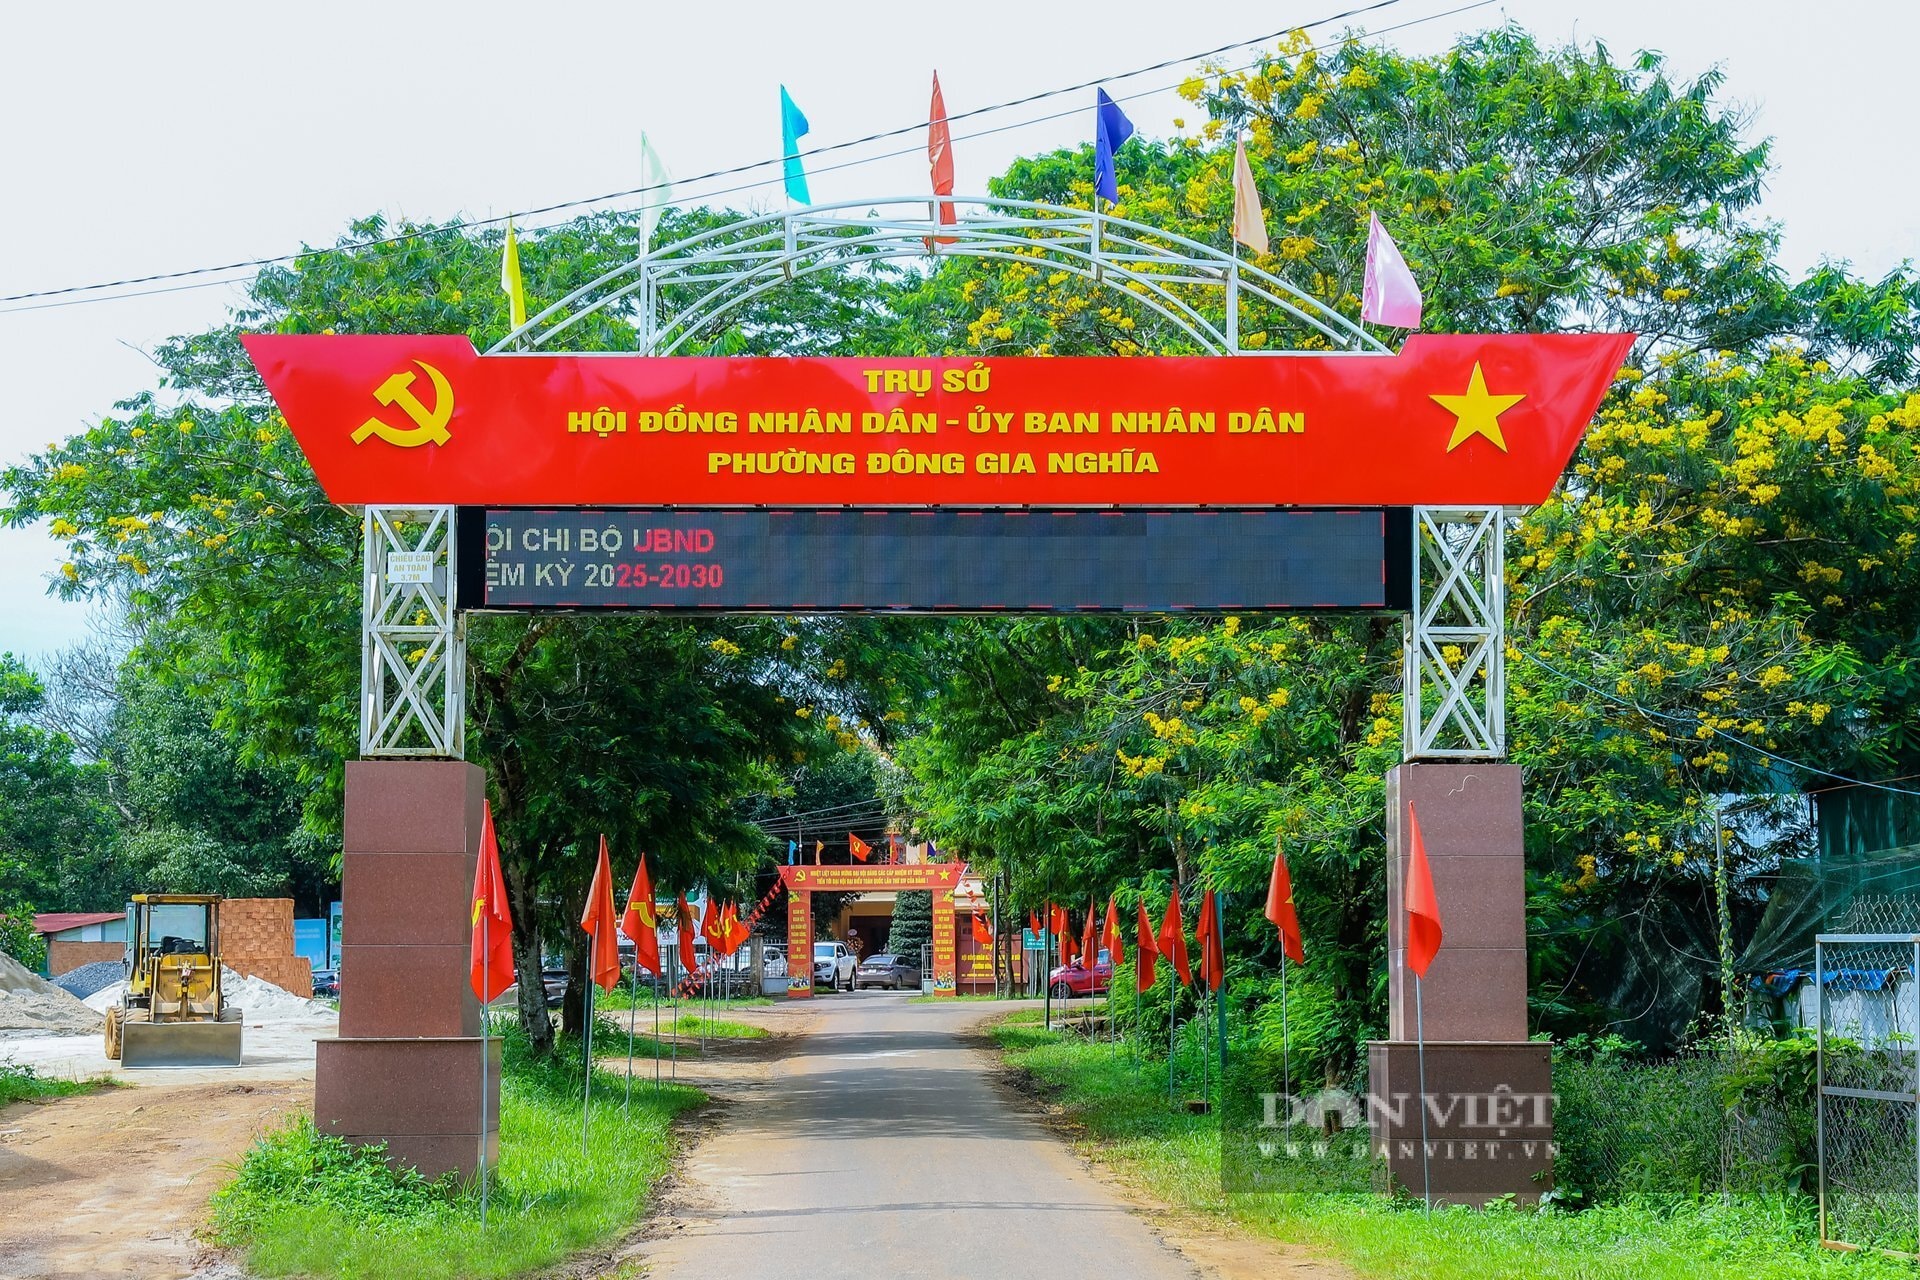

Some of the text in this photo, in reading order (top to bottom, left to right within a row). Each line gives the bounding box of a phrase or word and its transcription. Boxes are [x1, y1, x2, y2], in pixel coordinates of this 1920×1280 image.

[863, 362, 991, 397] TRỤ SỞ
[568, 406, 627, 437] HỘI
[638, 403, 738, 433] ĐỒNG
[749, 407, 852, 433] NHÂN
[862, 408, 938, 433] DÂN
[967, 405, 1014, 433] ỦY
[1024, 411, 1099, 433] BAN
[1111, 407, 1216, 433] NHÂN
[1228, 407, 1305, 433] DÂN
[708, 447, 1160, 474] PHƯỜNG ĐÔNG GIA NGHĨA
[522, 528, 570, 552] CHI
[580, 524, 623, 557] BỘ
[633, 528, 715, 553] UBND
[535, 557, 575, 588] KỲ
[584, 563, 724, 588] 2025-2030
